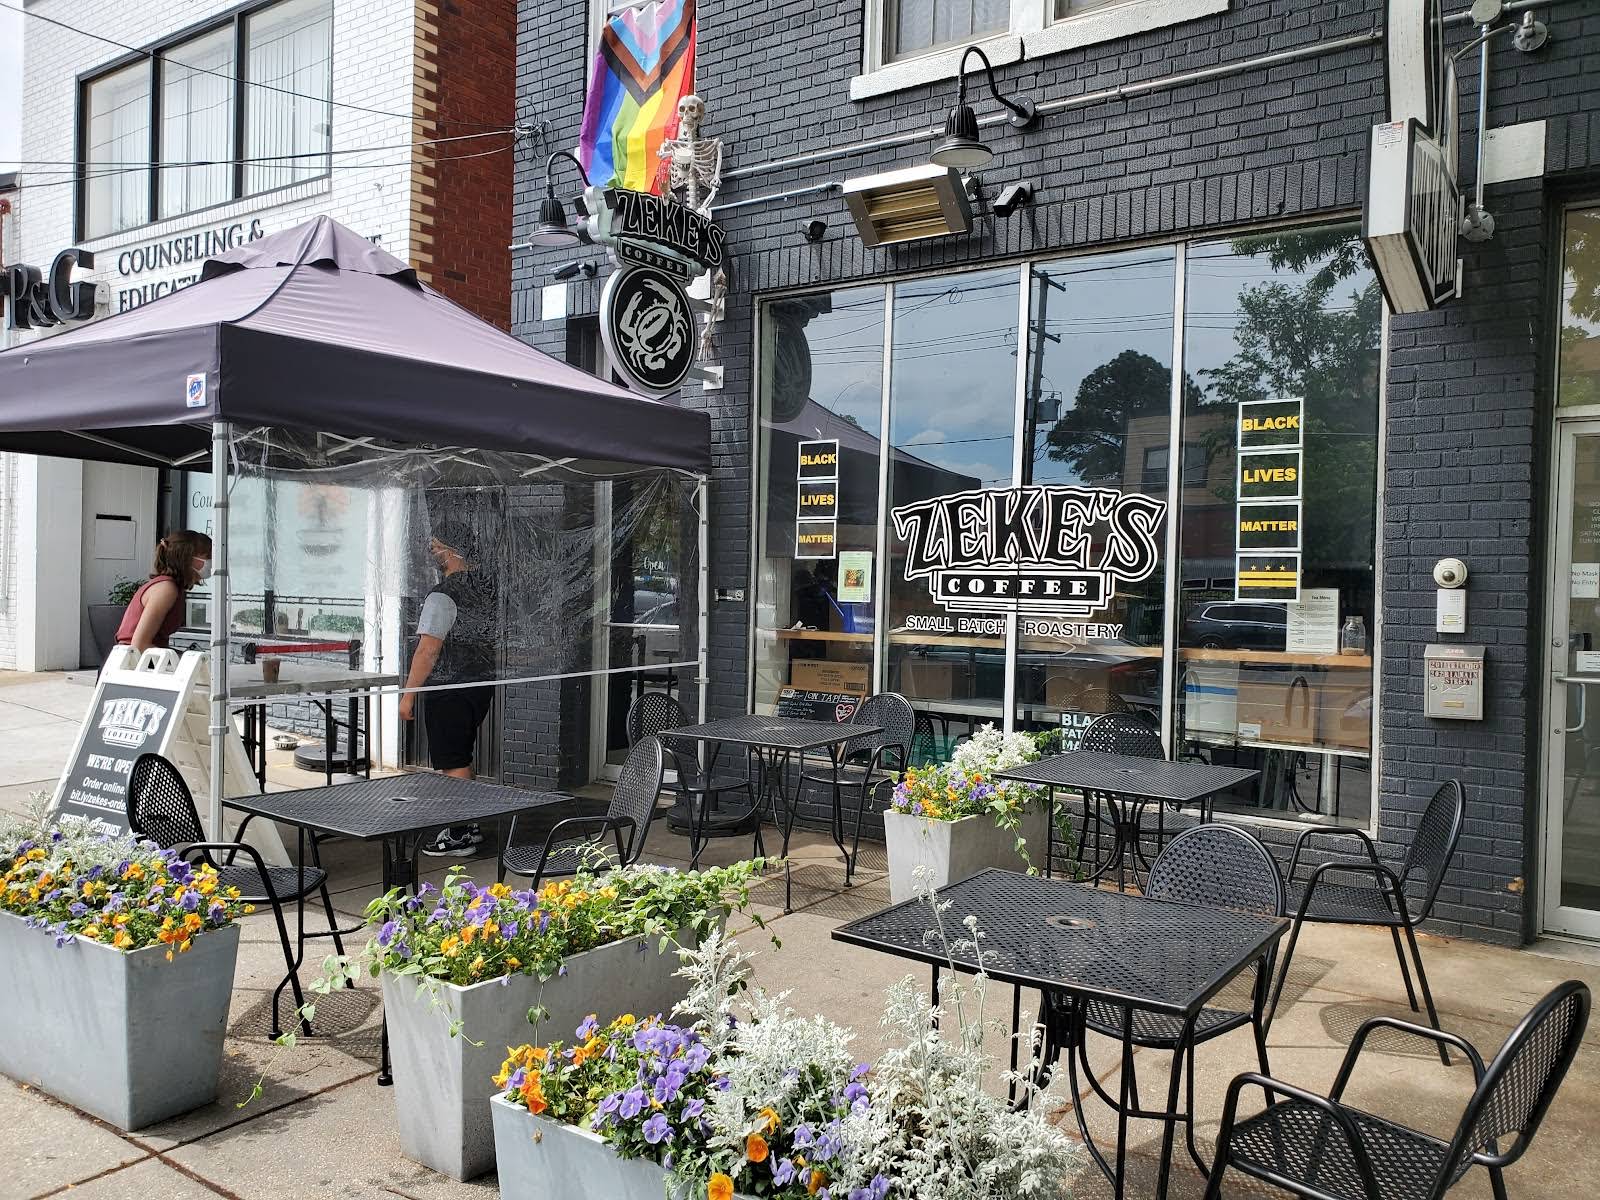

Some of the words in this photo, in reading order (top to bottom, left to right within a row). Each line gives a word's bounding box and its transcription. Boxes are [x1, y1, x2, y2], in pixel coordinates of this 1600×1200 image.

[614, 189, 727, 266] ZEKE'S
[118, 223, 243, 277] COUNSELING
[247, 218, 264, 242] &
[624, 244, 685, 274] COFFEE
[118, 274, 203, 314] EDUCAT
[1241, 415, 1300, 432] BLACK
[800, 453, 836, 466] BLACK
[1243, 467, 1297, 484] LIVES
[192, 491, 213, 510] Cou
[801, 493, 835, 506] LIVES
[891, 486, 1168, 583] ZEKE'S
[1240, 520, 1298, 532] MATTER
[799, 534, 834, 545] MATTER
[643, 556, 666, 575] Open
[1581, 570, 1599, 578] Mask
[947, 577, 1089, 597] COFFEE
[1581, 579, 1598, 587] Entry
[905, 615, 954, 632] SMALL
[957, 616, 1007, 635] BATCH
[1025, 621, 1123, 640] ROASTERY
[807, 692, 818, 700] ON
[822, 693, 841, 703] TAP
[98, 697, 168, 736] ZEKE'S
[1061, 713, 1096, 728] BLA
[1061, 727, 1083, 739] FAT
[1061, 739, 1080, 751] MA
[87, 753, 115, 771] WE'RE
[114, 758, 134, 774] OPE
[82, 776, 102, 790] Order
